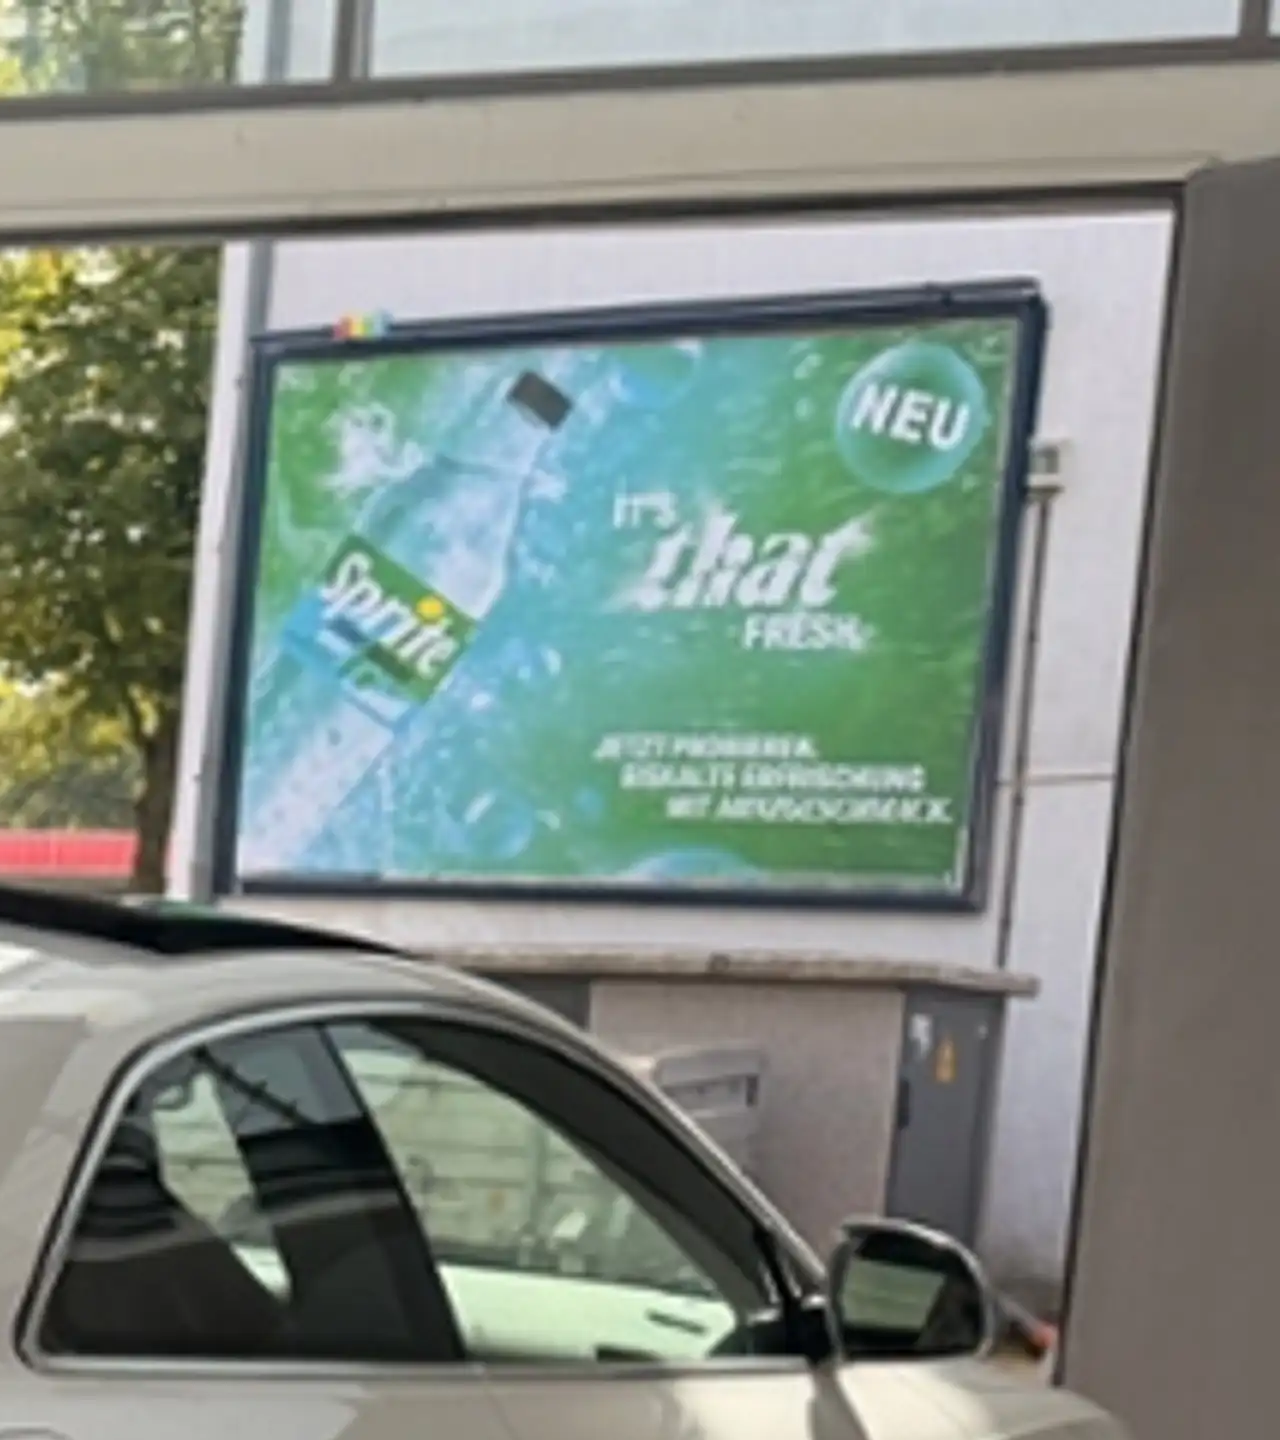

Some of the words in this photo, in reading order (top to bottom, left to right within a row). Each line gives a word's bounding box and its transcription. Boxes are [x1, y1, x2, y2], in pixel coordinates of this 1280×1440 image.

[850, 382, 971, 451] NEU
[625, 503, 875, 610] that
[320, 551, 459, 680] Sprite
